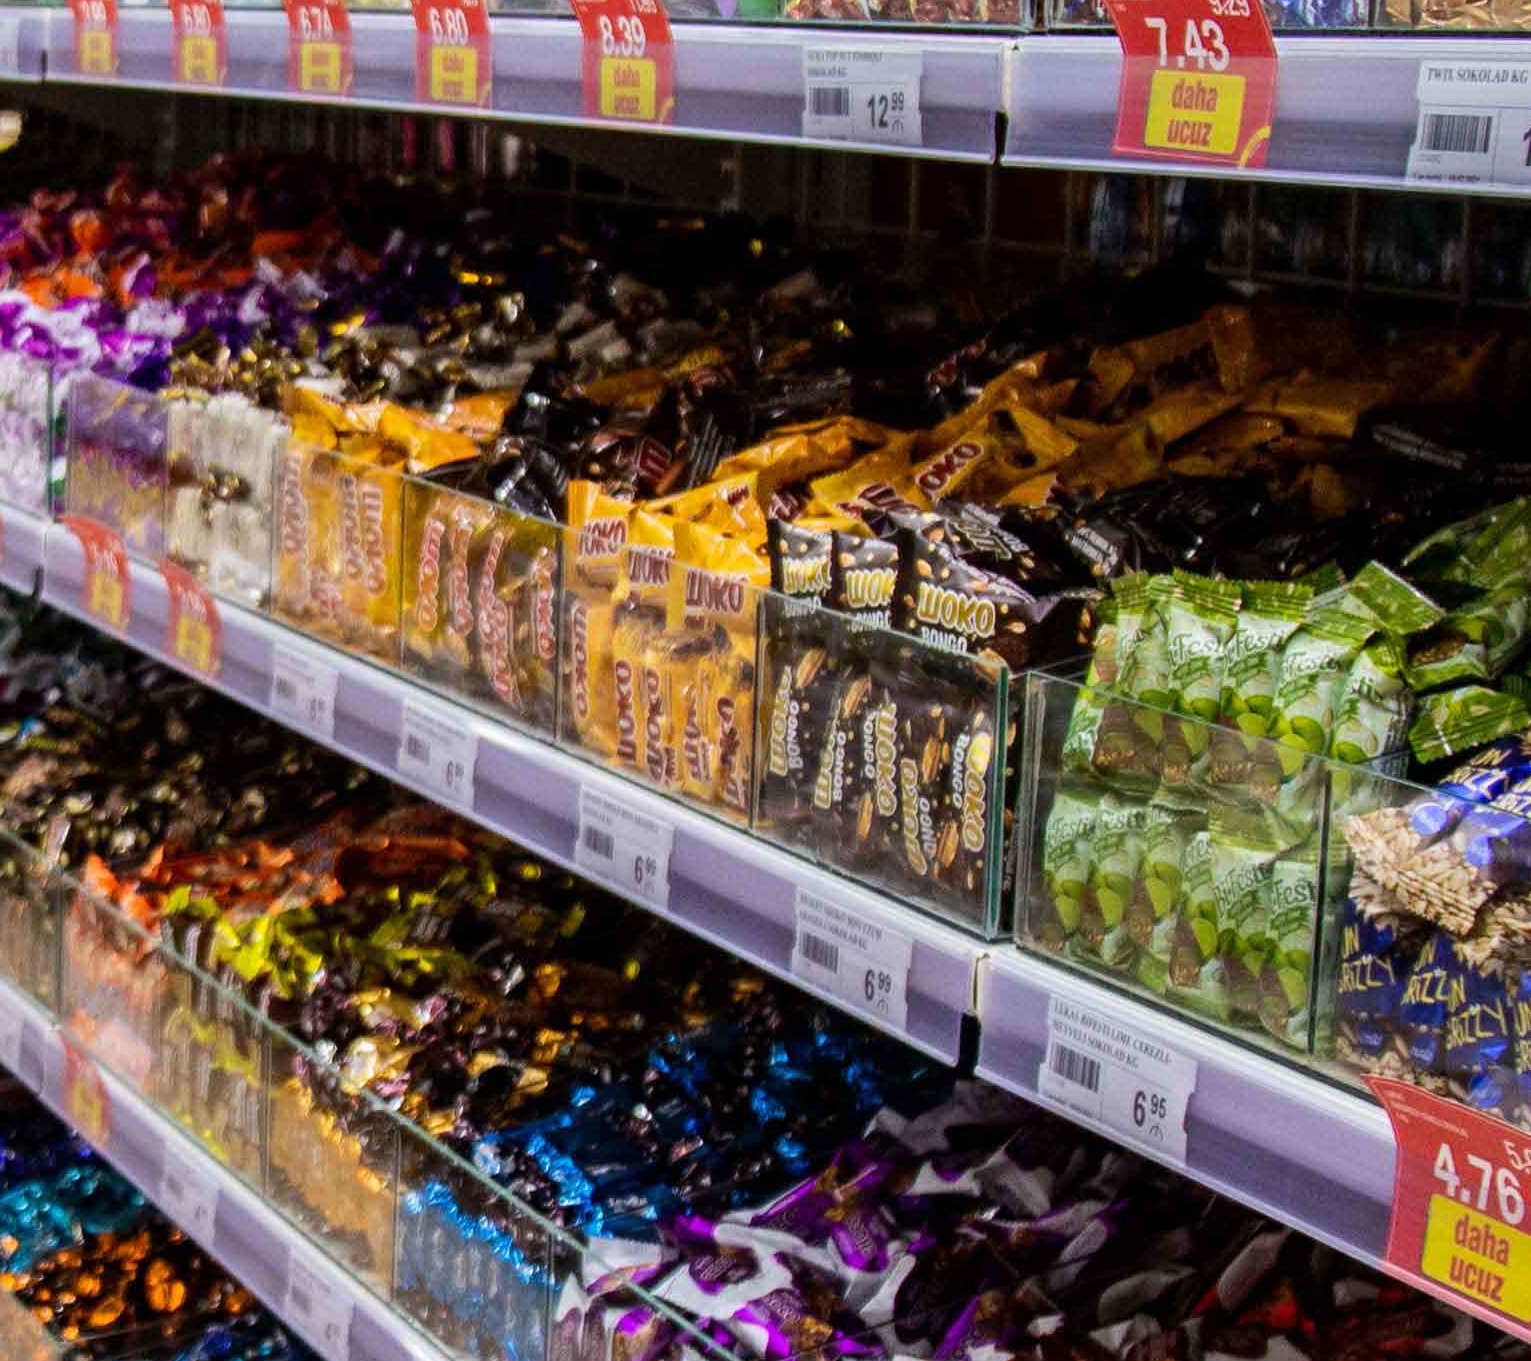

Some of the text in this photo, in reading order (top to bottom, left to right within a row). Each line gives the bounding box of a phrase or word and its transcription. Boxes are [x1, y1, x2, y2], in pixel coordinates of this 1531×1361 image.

[427, 8, 470, 46] 6.80
[598, 15, 647, 57] 8.39
[1144, 16, 1230, 72] 7.43
[1170, 78, 1220, 112] daha
[1456, 68, 1509, 84] SOKOLAD
[1510, 69, 1529, 85] KG
[867, 90, 906, 129] 12 99
[1167, 118, 1214, 147] ucuz
[685, 568, 745, 615] ШОКО
[917, 583, 997, 638] ШОКО
[865, 969, 893, 1002] 6 99
[1133, 1090, 1168, 1127] 6 95
[1432, 1142, 1526, 1225] 4.76
[1453, 1214, 1510, 1268] daha
[1448, 1255, 1505, 1304] ucuz
